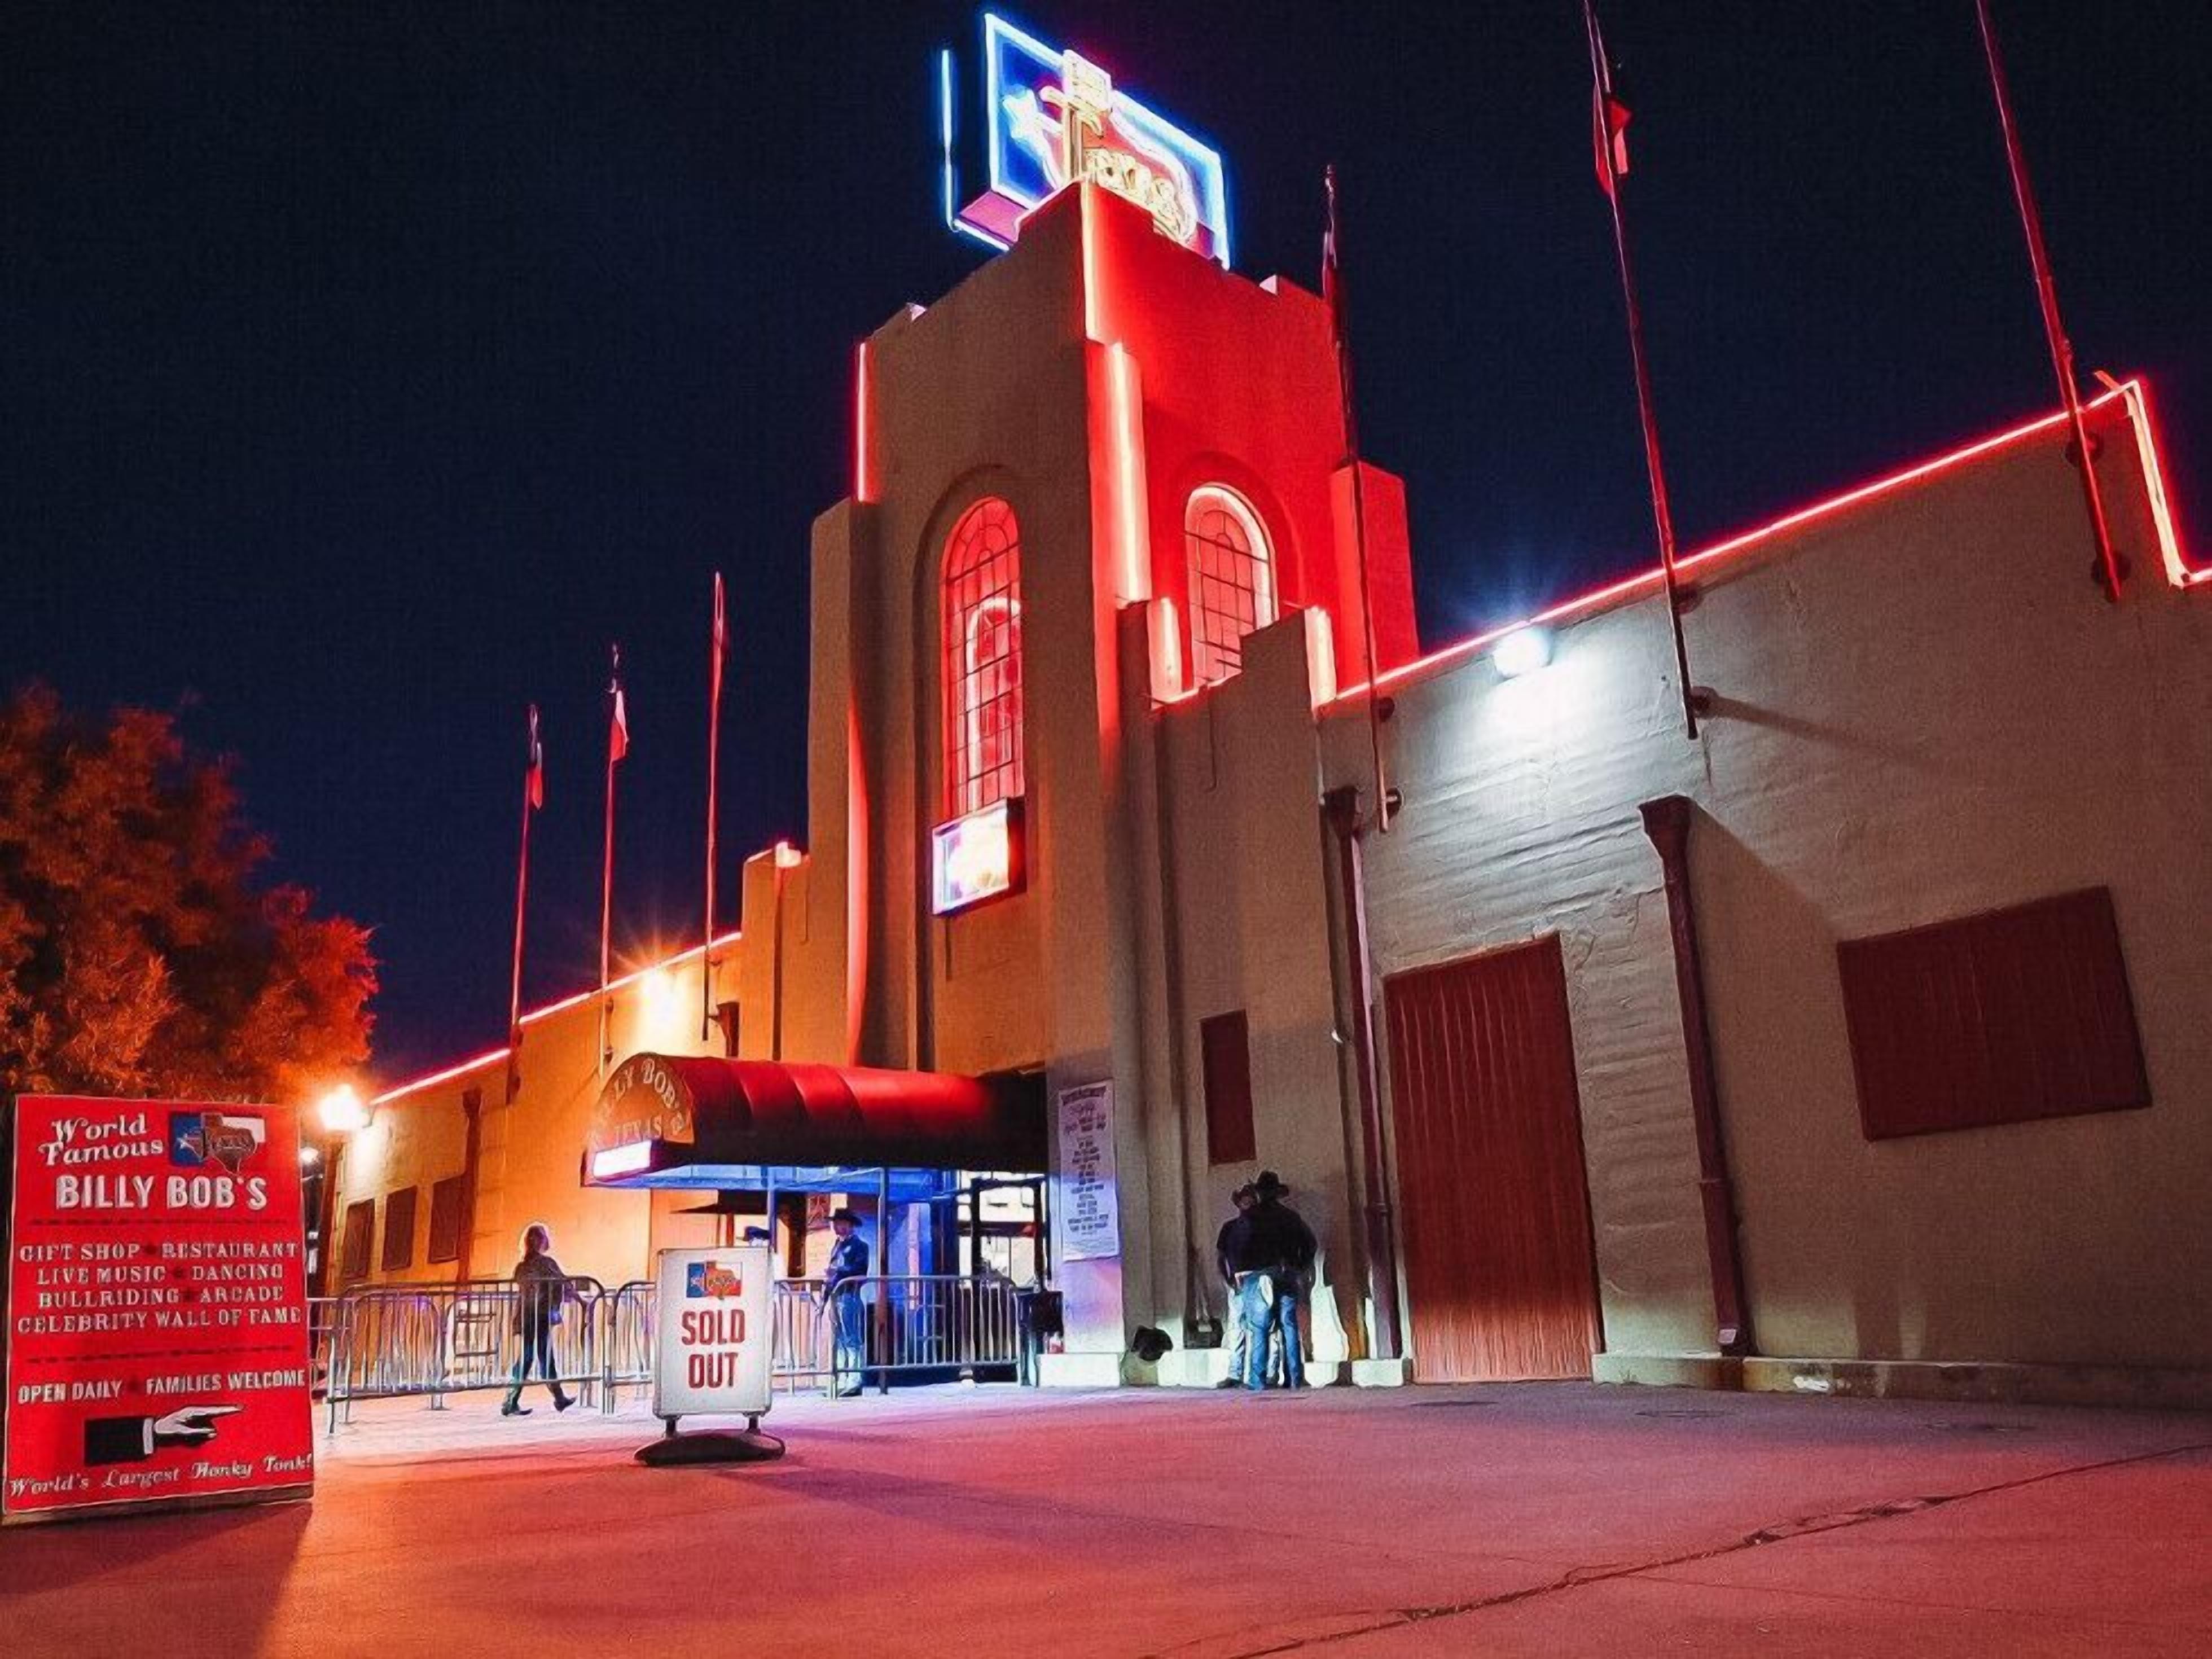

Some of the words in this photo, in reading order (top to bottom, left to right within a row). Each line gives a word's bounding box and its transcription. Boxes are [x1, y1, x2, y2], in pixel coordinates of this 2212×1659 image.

[51, 1113, 147, 1143] World
[38, 1138, 164, 1166] Famous
[58, 1174, 154, 1209] BILLY
[167, 1175, 267, 1210] BOB'S
[20, 1244, 73, 1262] GIFT
[81, 1243, 140, 1260] SHOP
[162, 1243, 296, 1259] RESTAURANT
[37, 1267, 89, 1285] LIVE
[97, 1266, 165, 1284] MUSIC
[192, 1263, 283, 1280] DANCING
[39, 1288, 179, 1309] BULLRIDING
[200, 1286, 283, 1303] ARCADE
[17, 1312, 147, 1333] CELEBRITY
[155, 1310, 210, 1327] WALL
[219, 1309, 242, 1326] OF
[249, 1307, 301, 1324] FAME
[681, 1309, 745, 1345] SOLD
[688, 1353, 739, 1388] OUT
[18, 1385, 65, 1404] OPEN
[72, 1380, 122, 1400] DAILY
[147, 1374, 221, 1395] FAMILIES
[228, 1370, 305, 1390] WELCOME
[10, 1473, 89, 1497] World's
[102, 1468, 179, 1489] Largest
[190, 1460, 253, 1478] Honky
